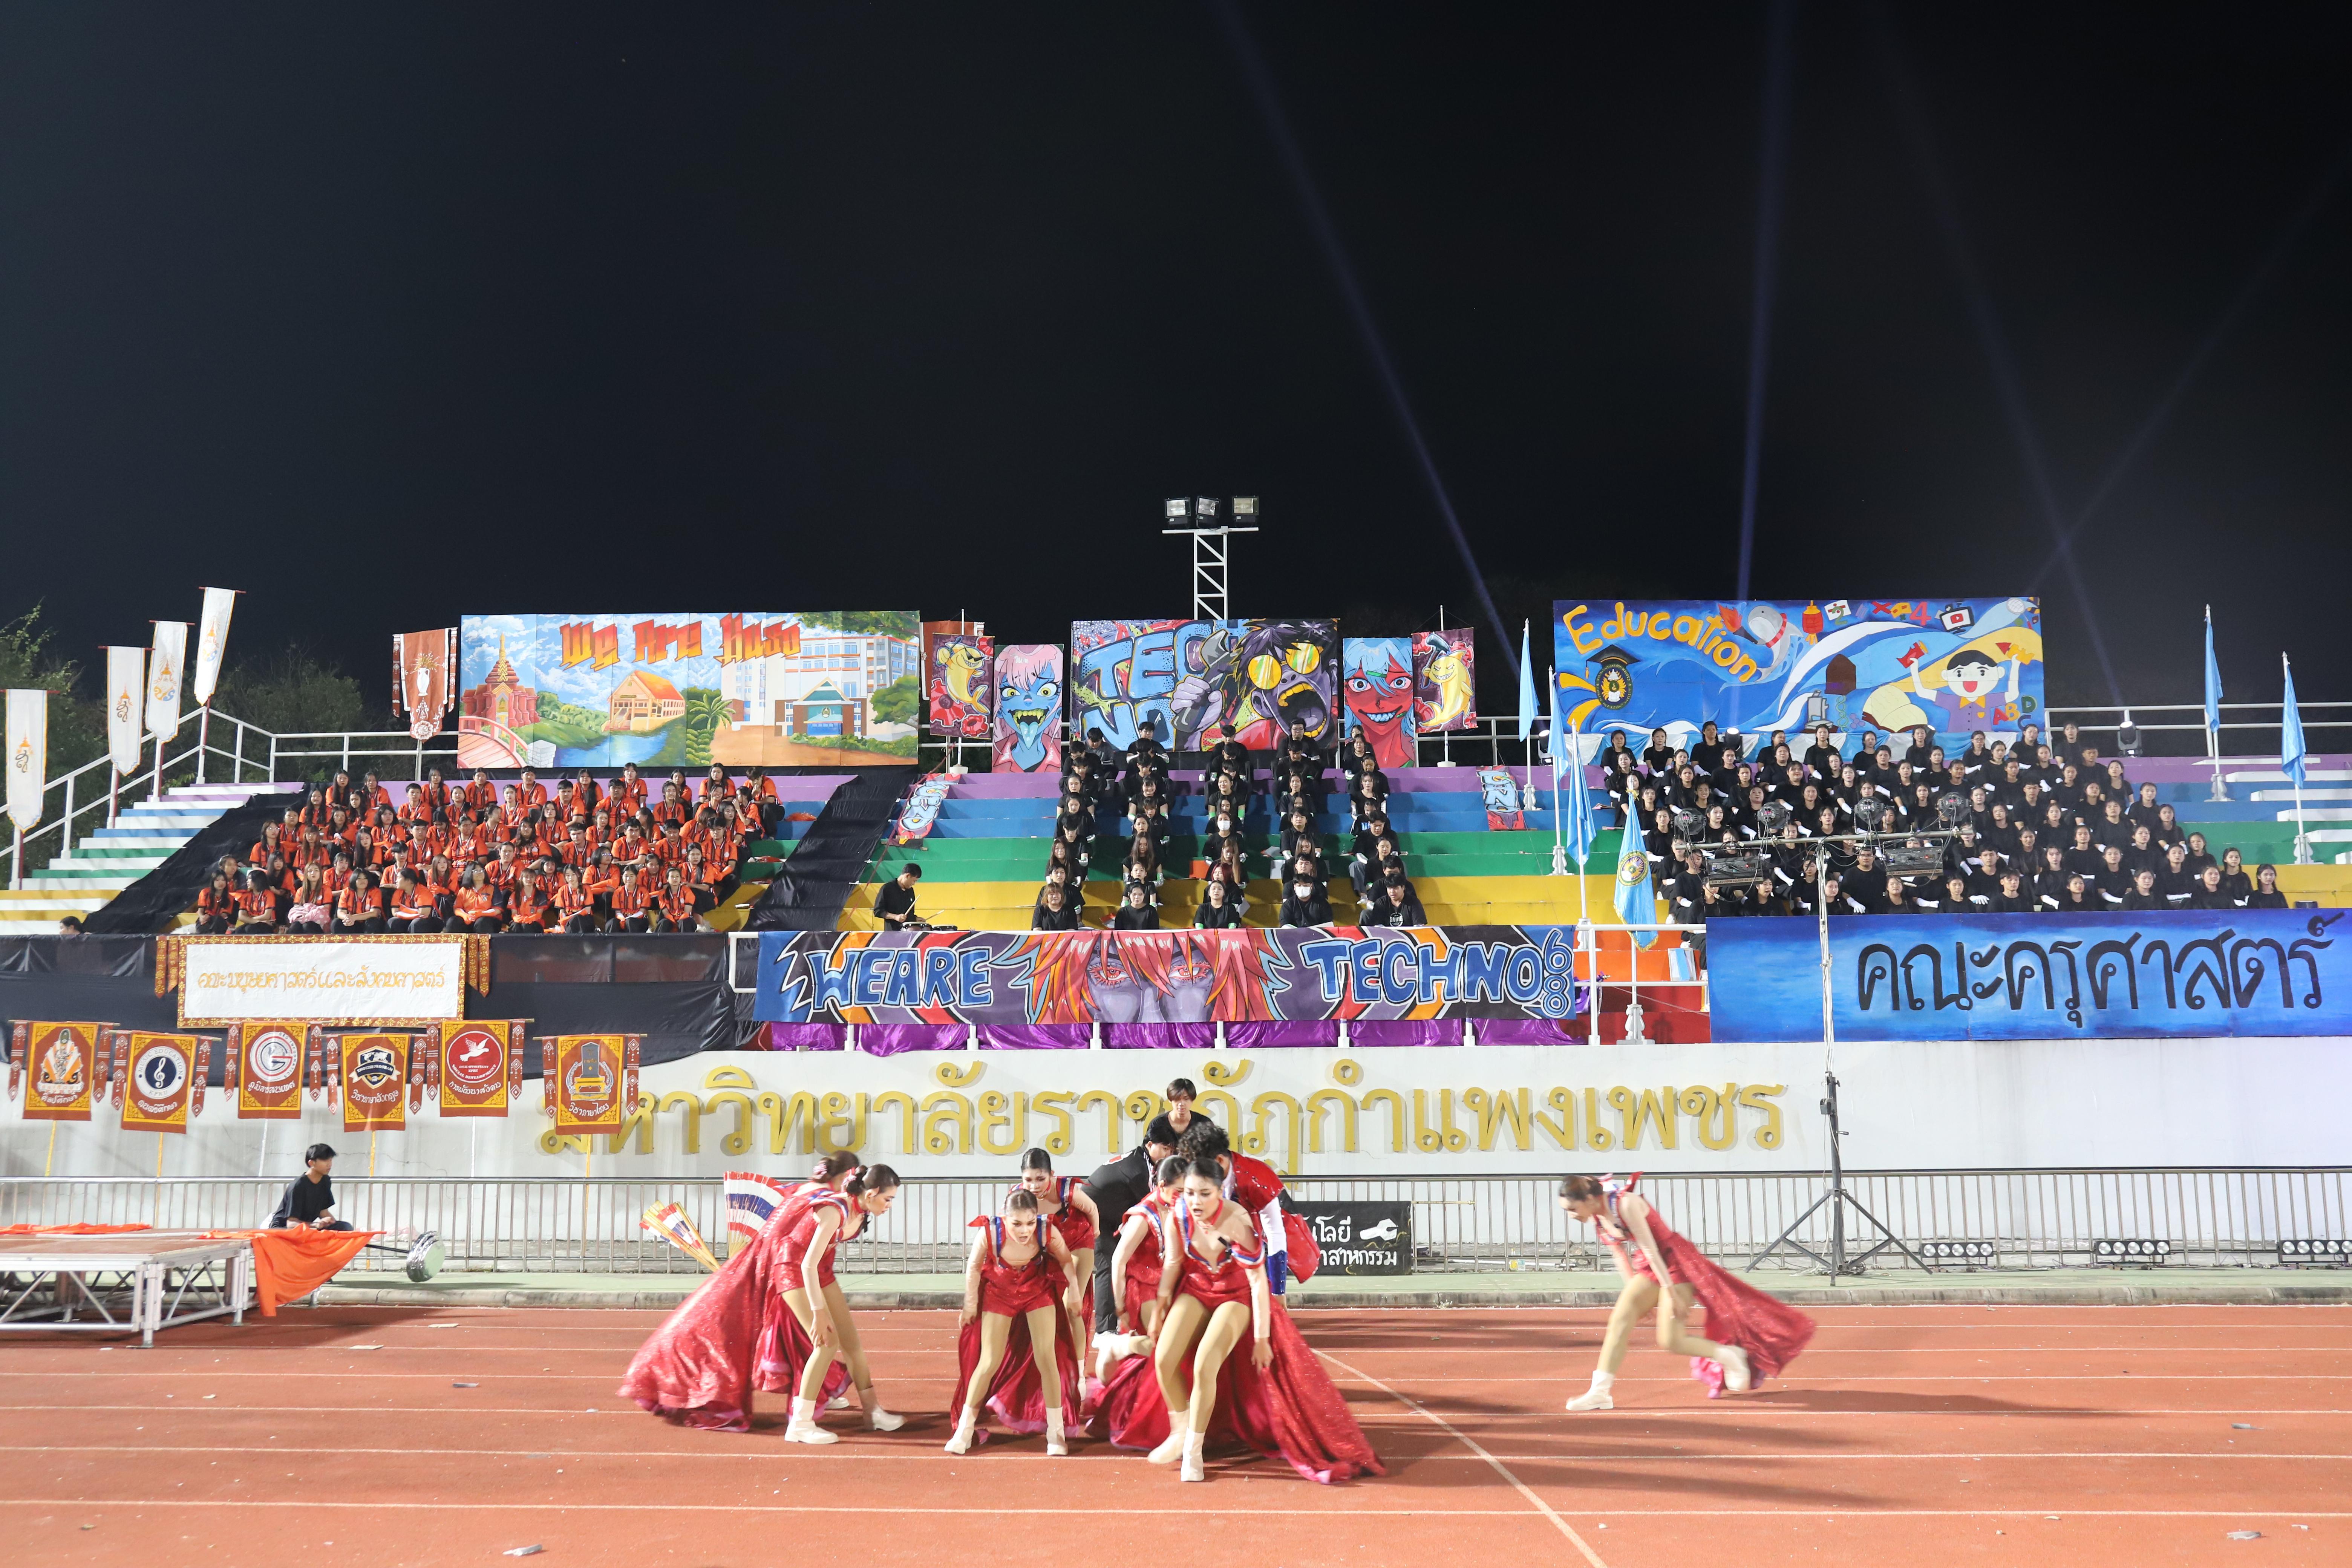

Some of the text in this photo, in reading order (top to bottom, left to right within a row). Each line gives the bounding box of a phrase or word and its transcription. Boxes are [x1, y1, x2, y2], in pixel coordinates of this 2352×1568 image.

[1563, 602, 1757, 682] Education
[198, 964, 445, 994] คณะมนุษยศาสตร์และสังคมศาสตร์
[1302, 941, 1543, 1006] TECHNO
[1858, 912, 2345, 1028] คณะครุศาสตร์
[138, 1049, 184, 1075] MUSIC EDUCATION
[452, 1063, 497, 1079] SOCIAL DEVELOPMENT
[568, 1102, 609, 1116] วิชาภาษาไทย
